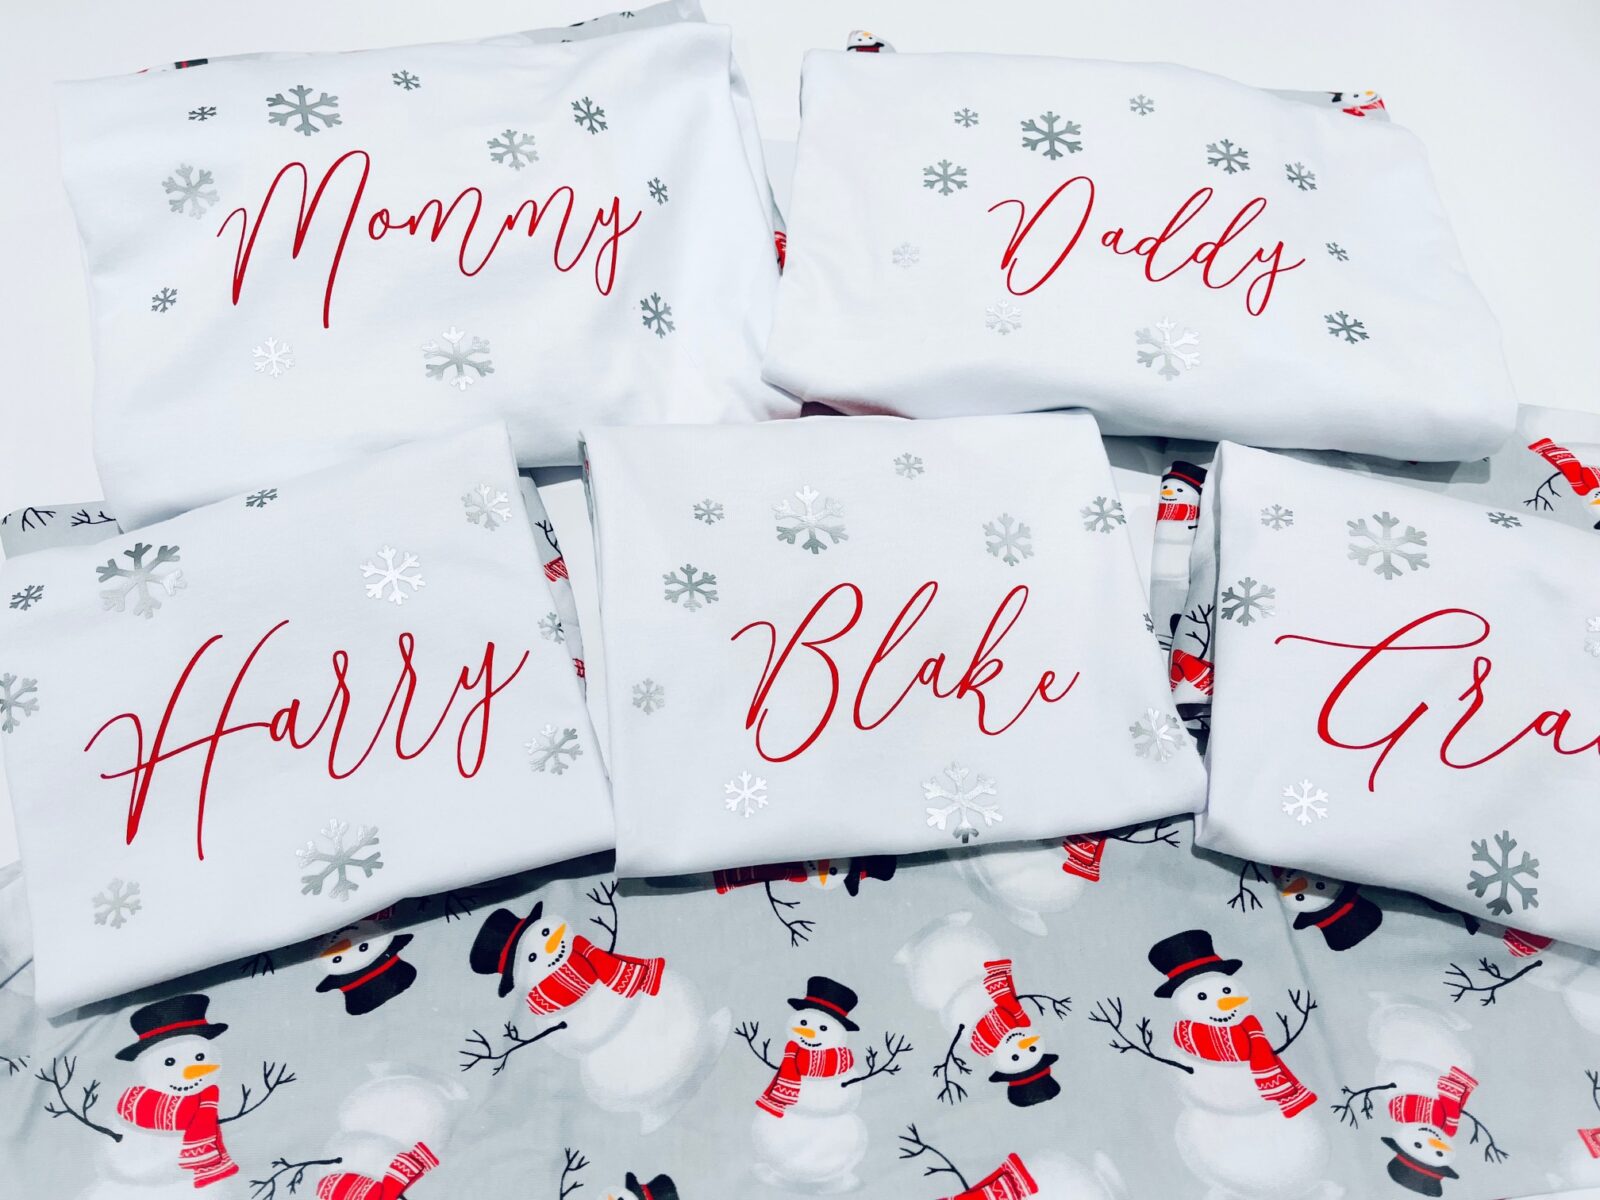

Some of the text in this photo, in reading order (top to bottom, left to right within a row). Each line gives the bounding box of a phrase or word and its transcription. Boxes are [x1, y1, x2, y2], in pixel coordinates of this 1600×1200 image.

[217, 149, 643, 329] Mommy
[988, 175, 1306, 317] Daddy
[84, 619, 530, 861] Harry
[730, 581, 1081, 764] Blake
[1274, 607, 1600, 793] Gra
